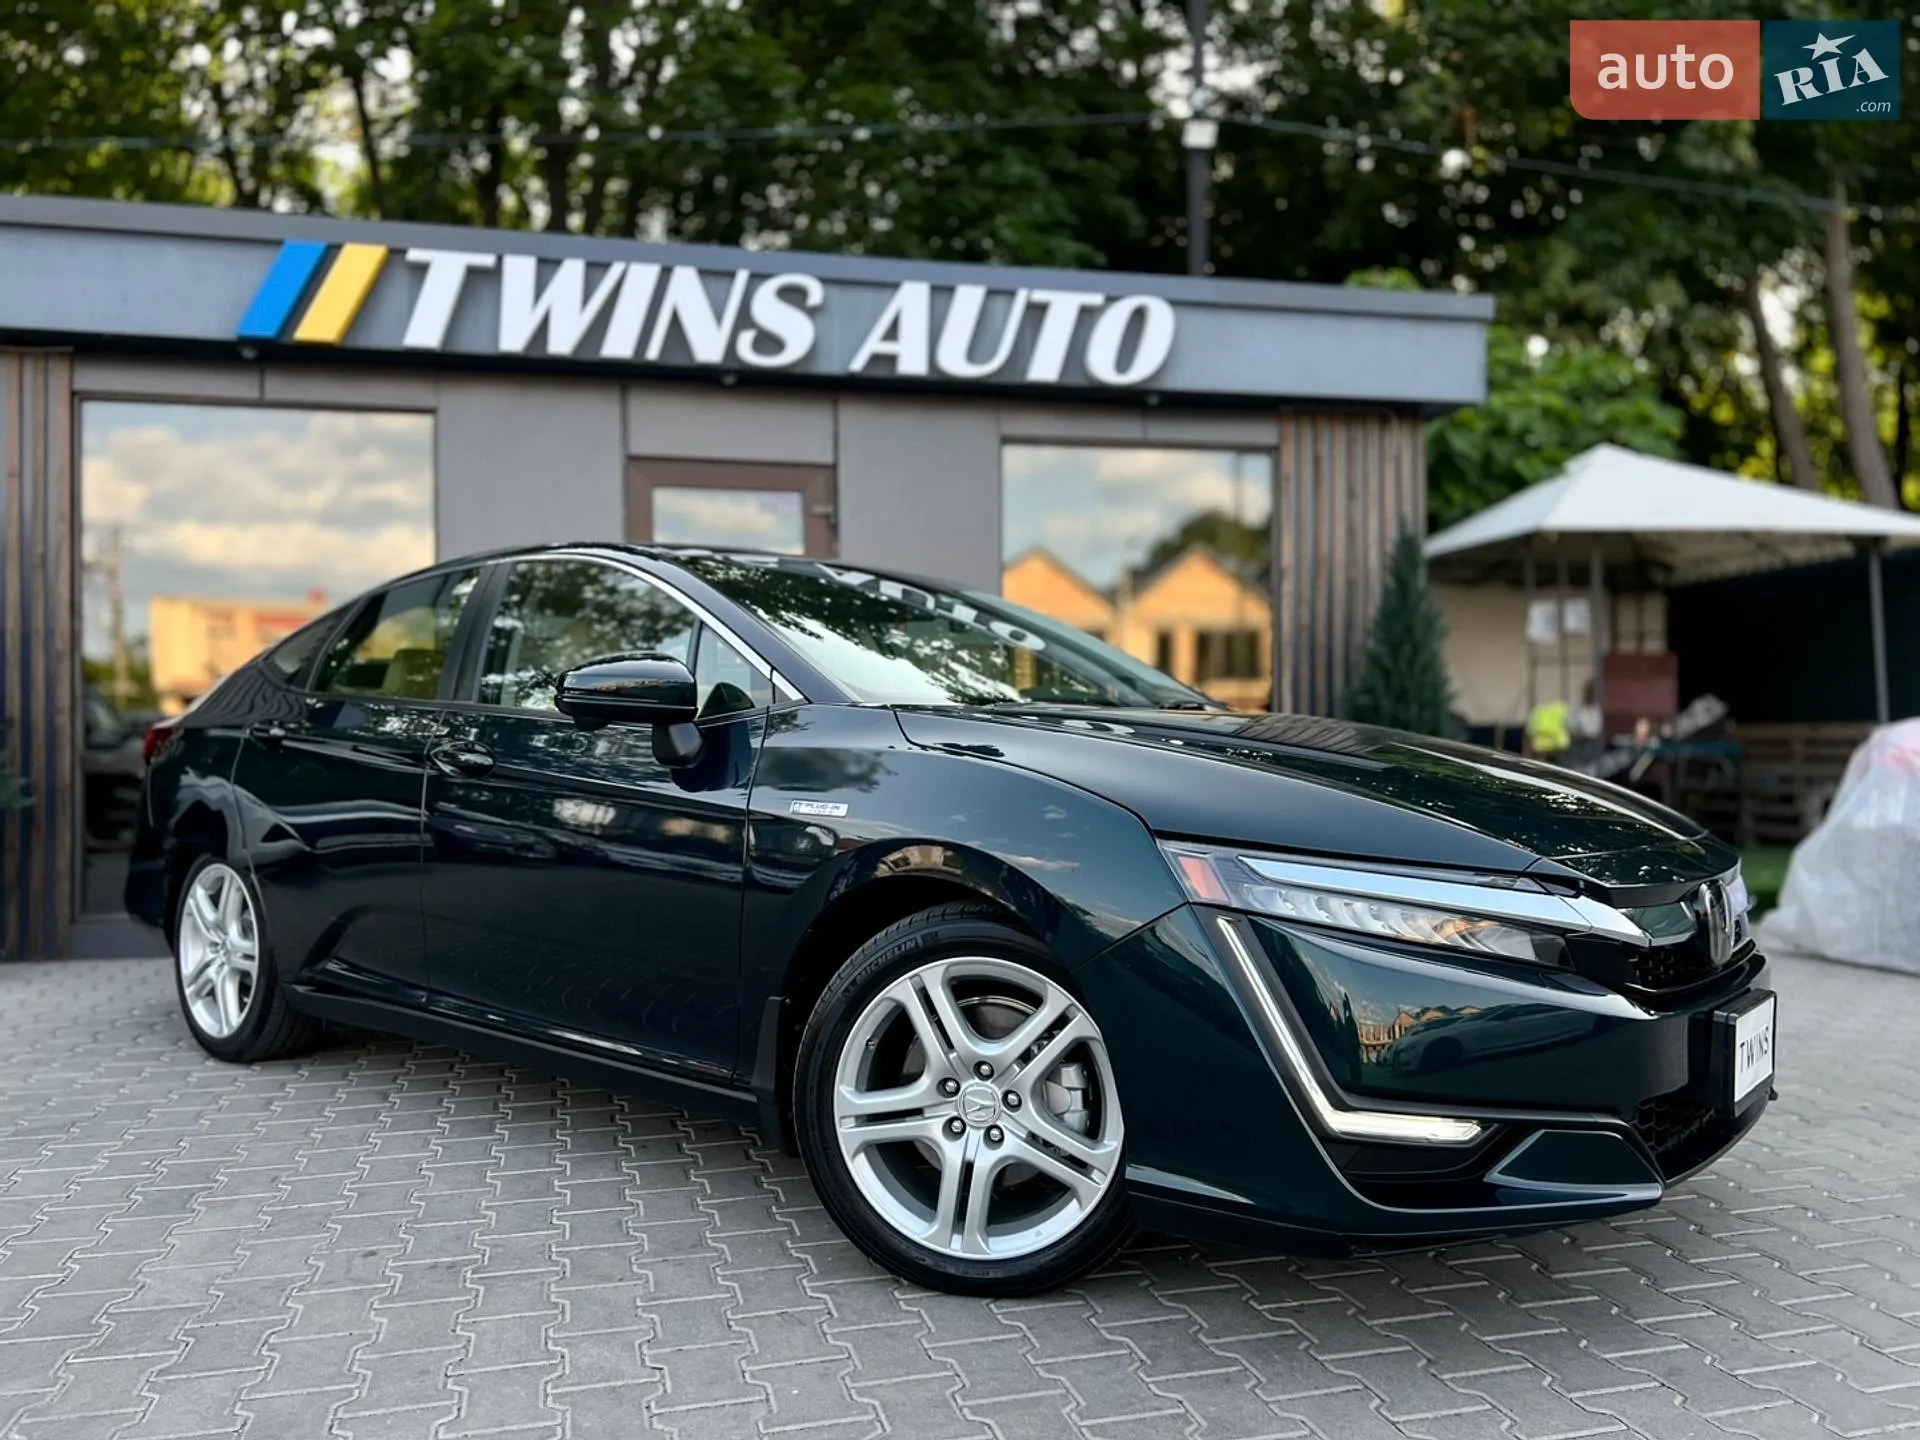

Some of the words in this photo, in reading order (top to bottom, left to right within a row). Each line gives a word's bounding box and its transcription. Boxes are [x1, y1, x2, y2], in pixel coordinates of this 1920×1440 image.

[402, 248, 824, 368] TWINS
[849, 280, 1176, 385] AUTO
[1740, 1026, 1770, 1073] TWINS
